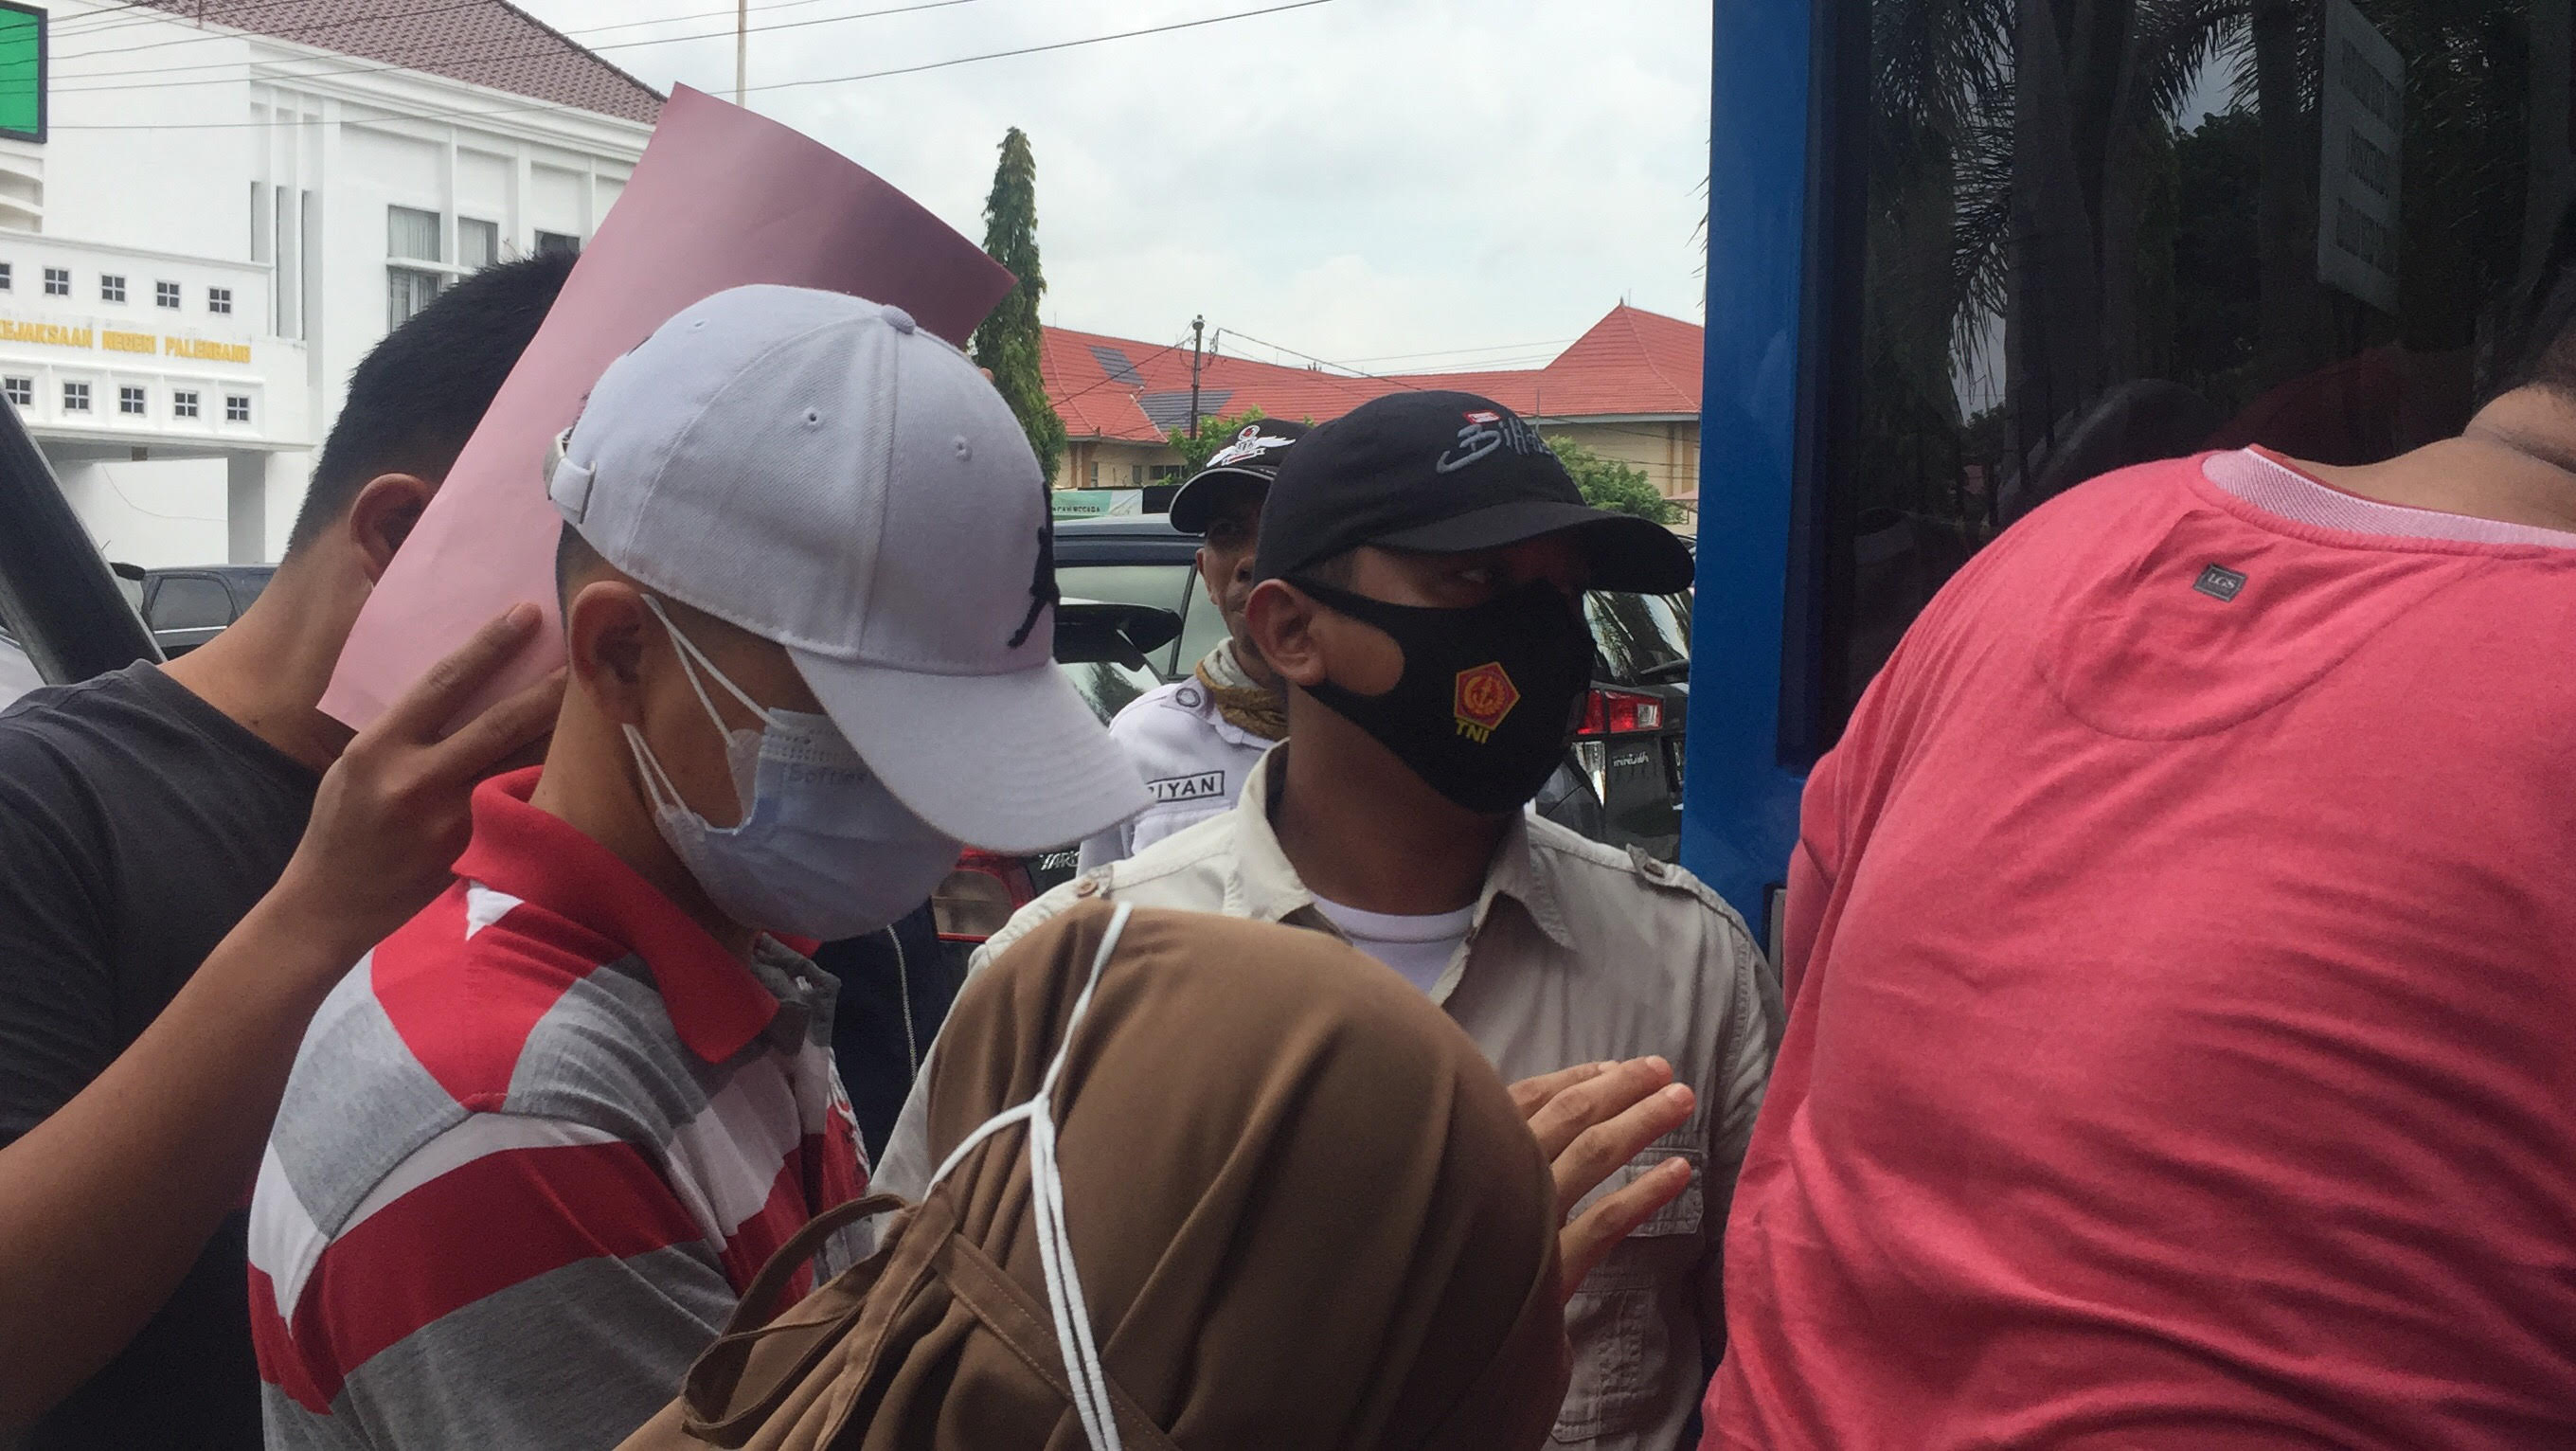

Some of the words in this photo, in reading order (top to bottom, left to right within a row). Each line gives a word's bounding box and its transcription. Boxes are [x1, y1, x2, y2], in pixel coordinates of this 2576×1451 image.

[101, 331, 156, 354] NEGERI
[165, 335, 251, 364] PALEMBANG
[1456, 720, 1490, 743] TNI
